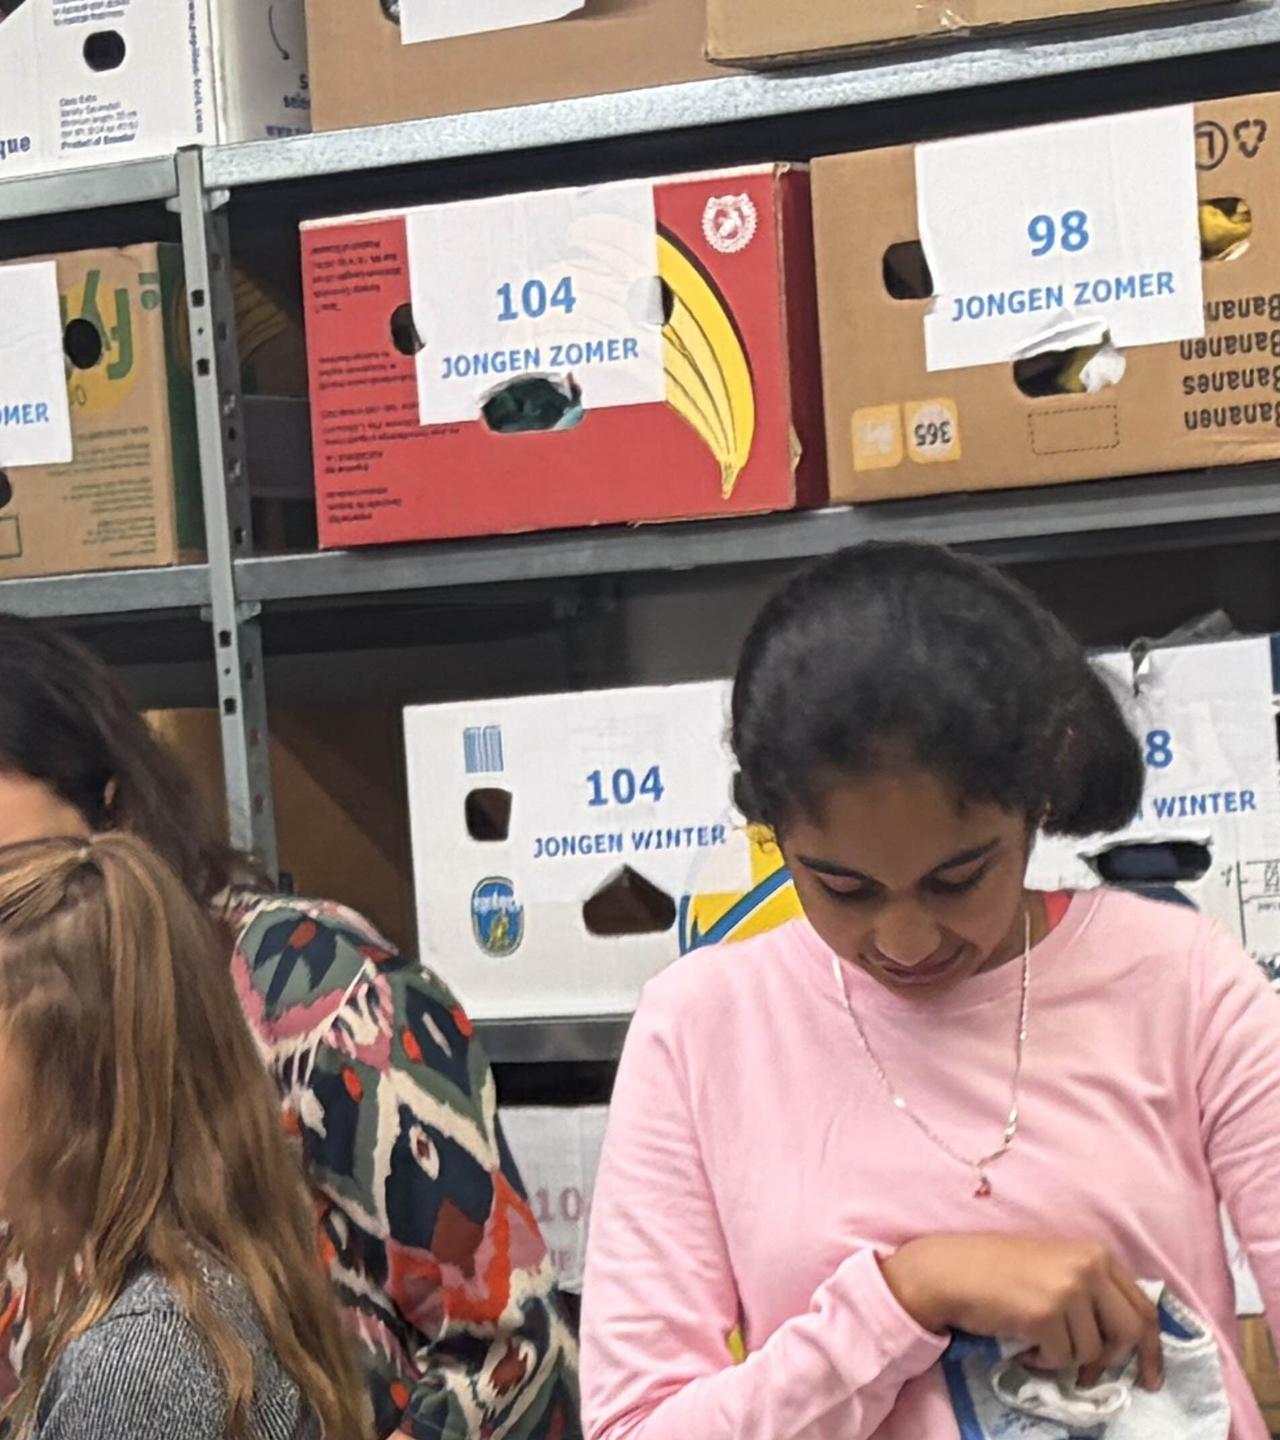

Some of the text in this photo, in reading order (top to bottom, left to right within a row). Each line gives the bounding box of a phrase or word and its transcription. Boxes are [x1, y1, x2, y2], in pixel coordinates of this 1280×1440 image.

[1027, 210, 1090, 256] 98
[496, 276, 577, 321] 104
[951, 271, 1176, 323] JONGEN ZOMER
[441, 338, 640, 381] JONGEN ZOMER
[914, 415, 952, 446] 365
[1145, 729, 1174, 769] 8
[586, 766, 664, 807] 104
[1154, 790, 1256, 818] WINTER
[534, 824, 726, 858] JONGEN WINTER
[534, 1187, 582, 1224] 10
